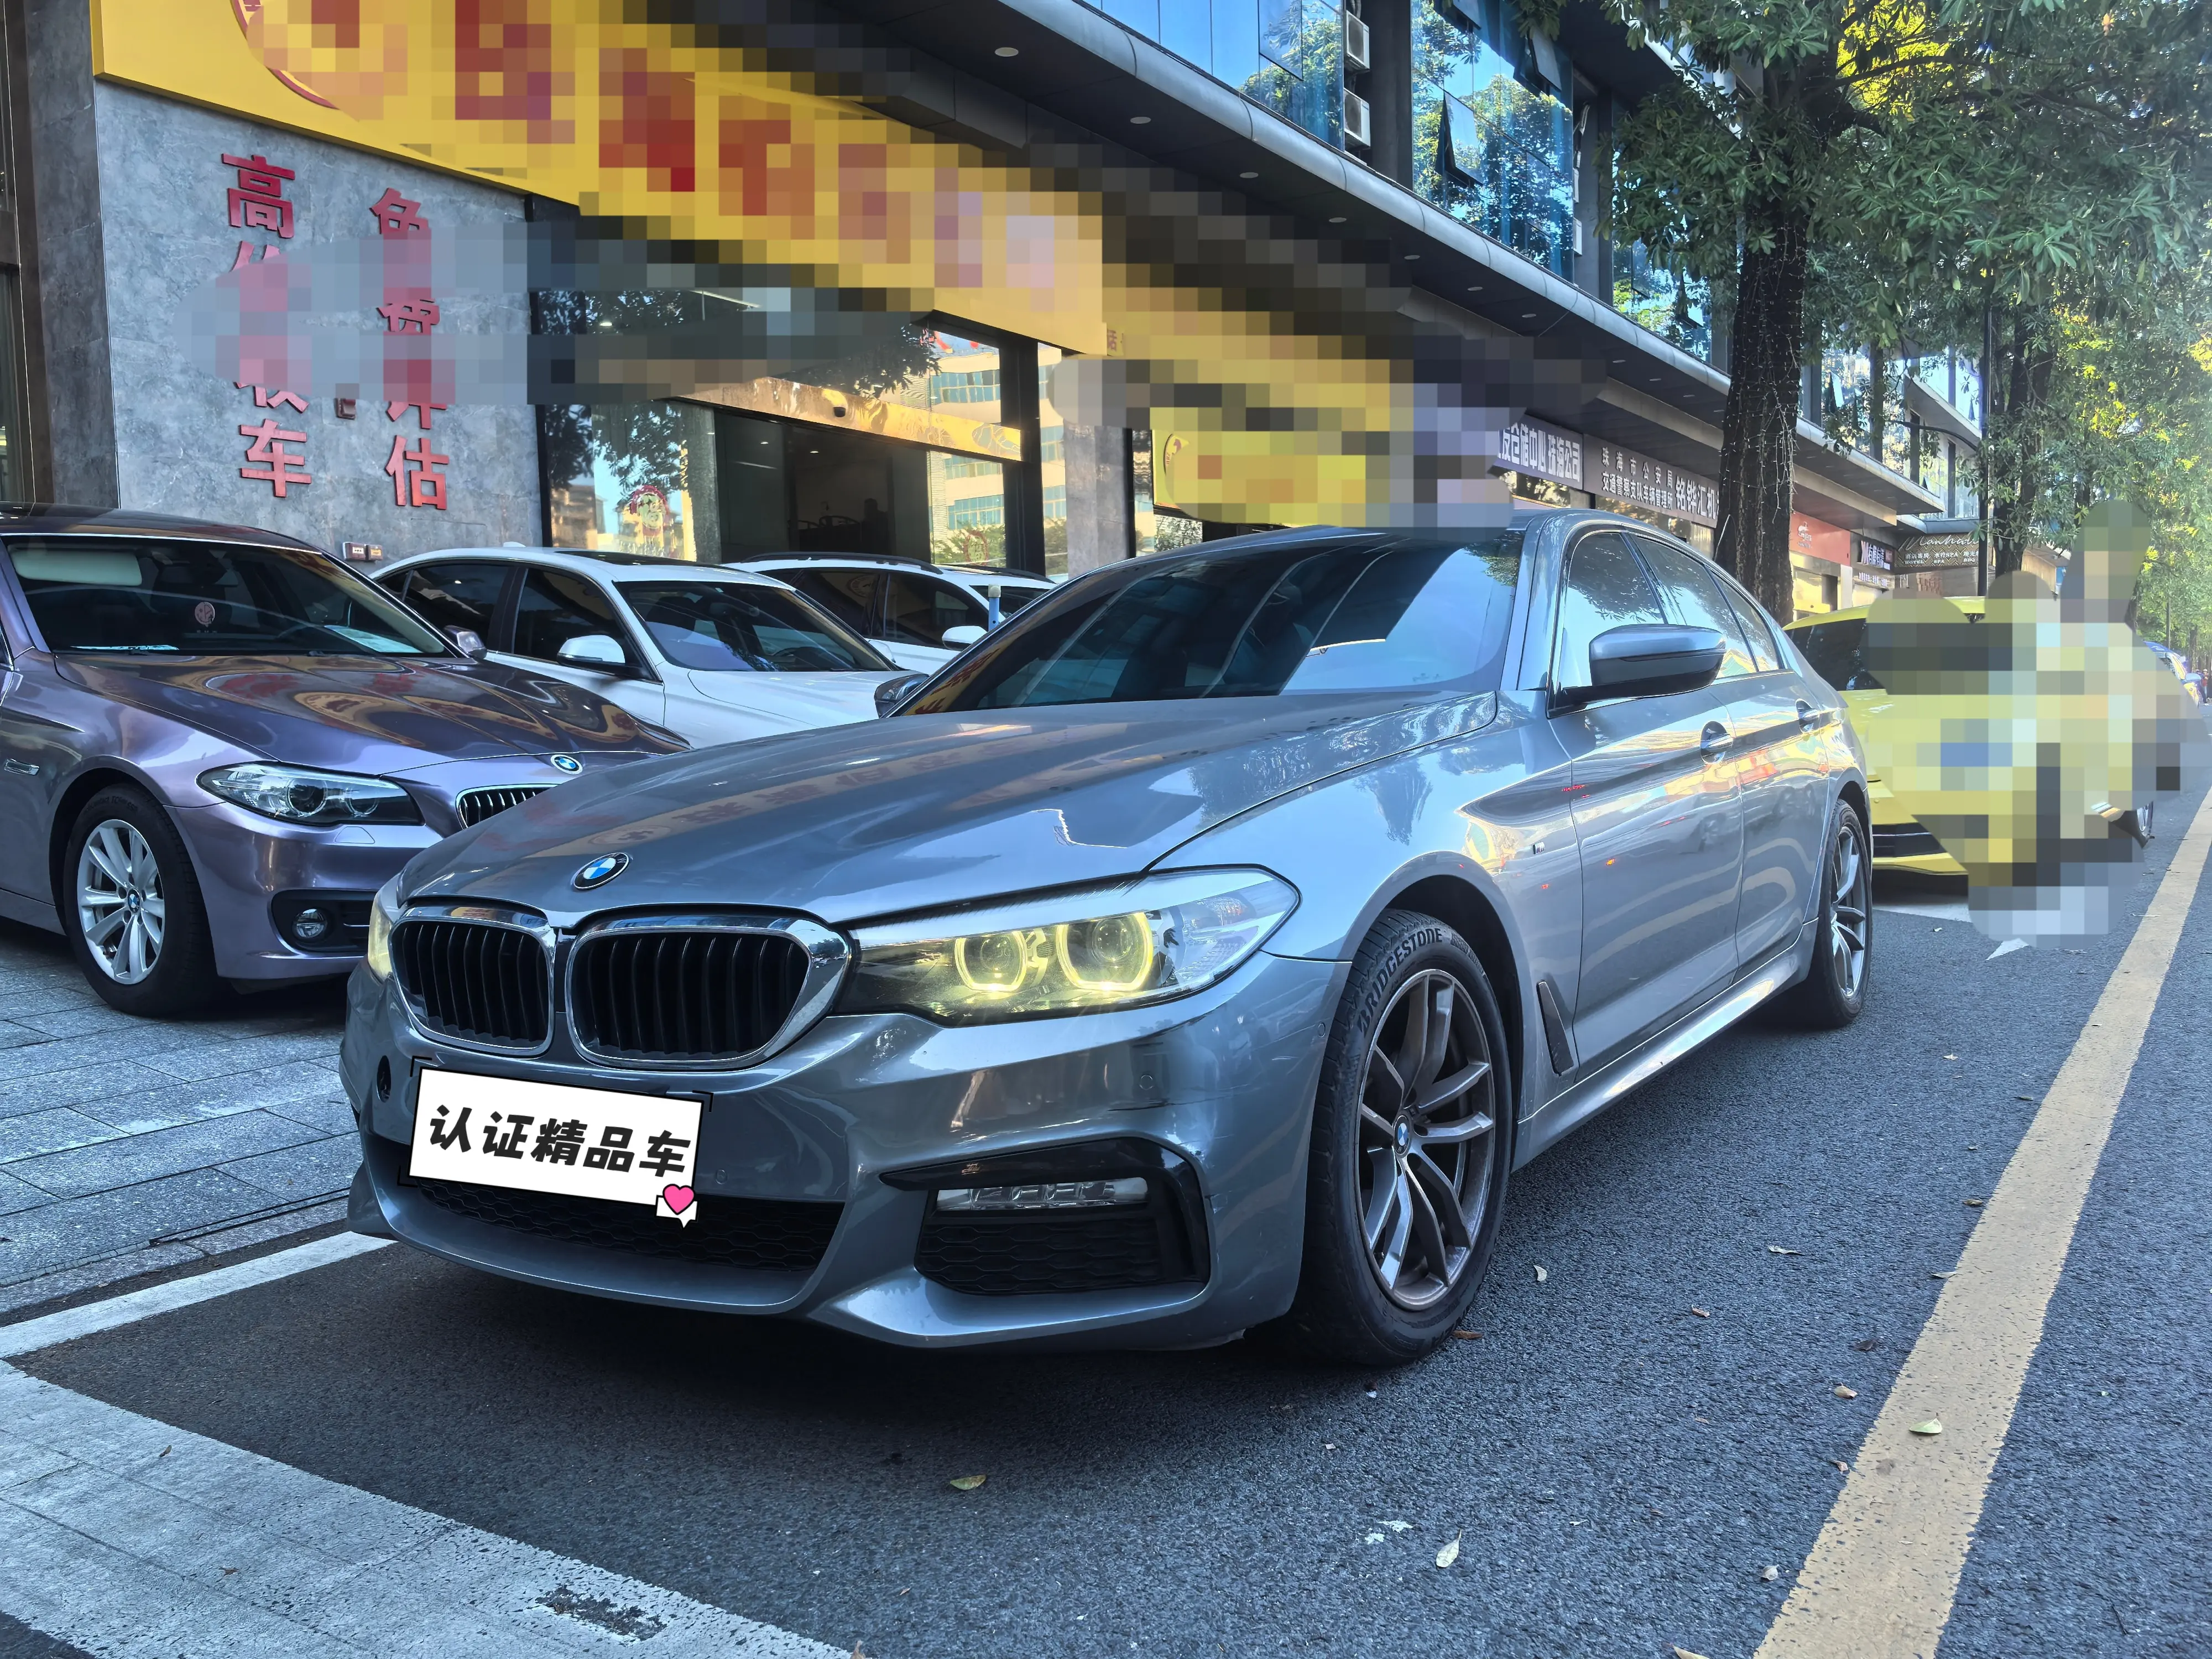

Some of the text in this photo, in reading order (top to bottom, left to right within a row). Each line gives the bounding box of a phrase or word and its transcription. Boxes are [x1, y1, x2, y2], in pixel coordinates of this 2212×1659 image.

[222, 153, 311, 498] 高车
[1548, 434, 1580, 483] 珠海公司
[1602, 447, 1673, 489] 珠海市公安局
[1602, 471, 1673, 510] 交通警察支队车辆管理所
[1357, 928, 1442, 1039] BRIDGESTONE
